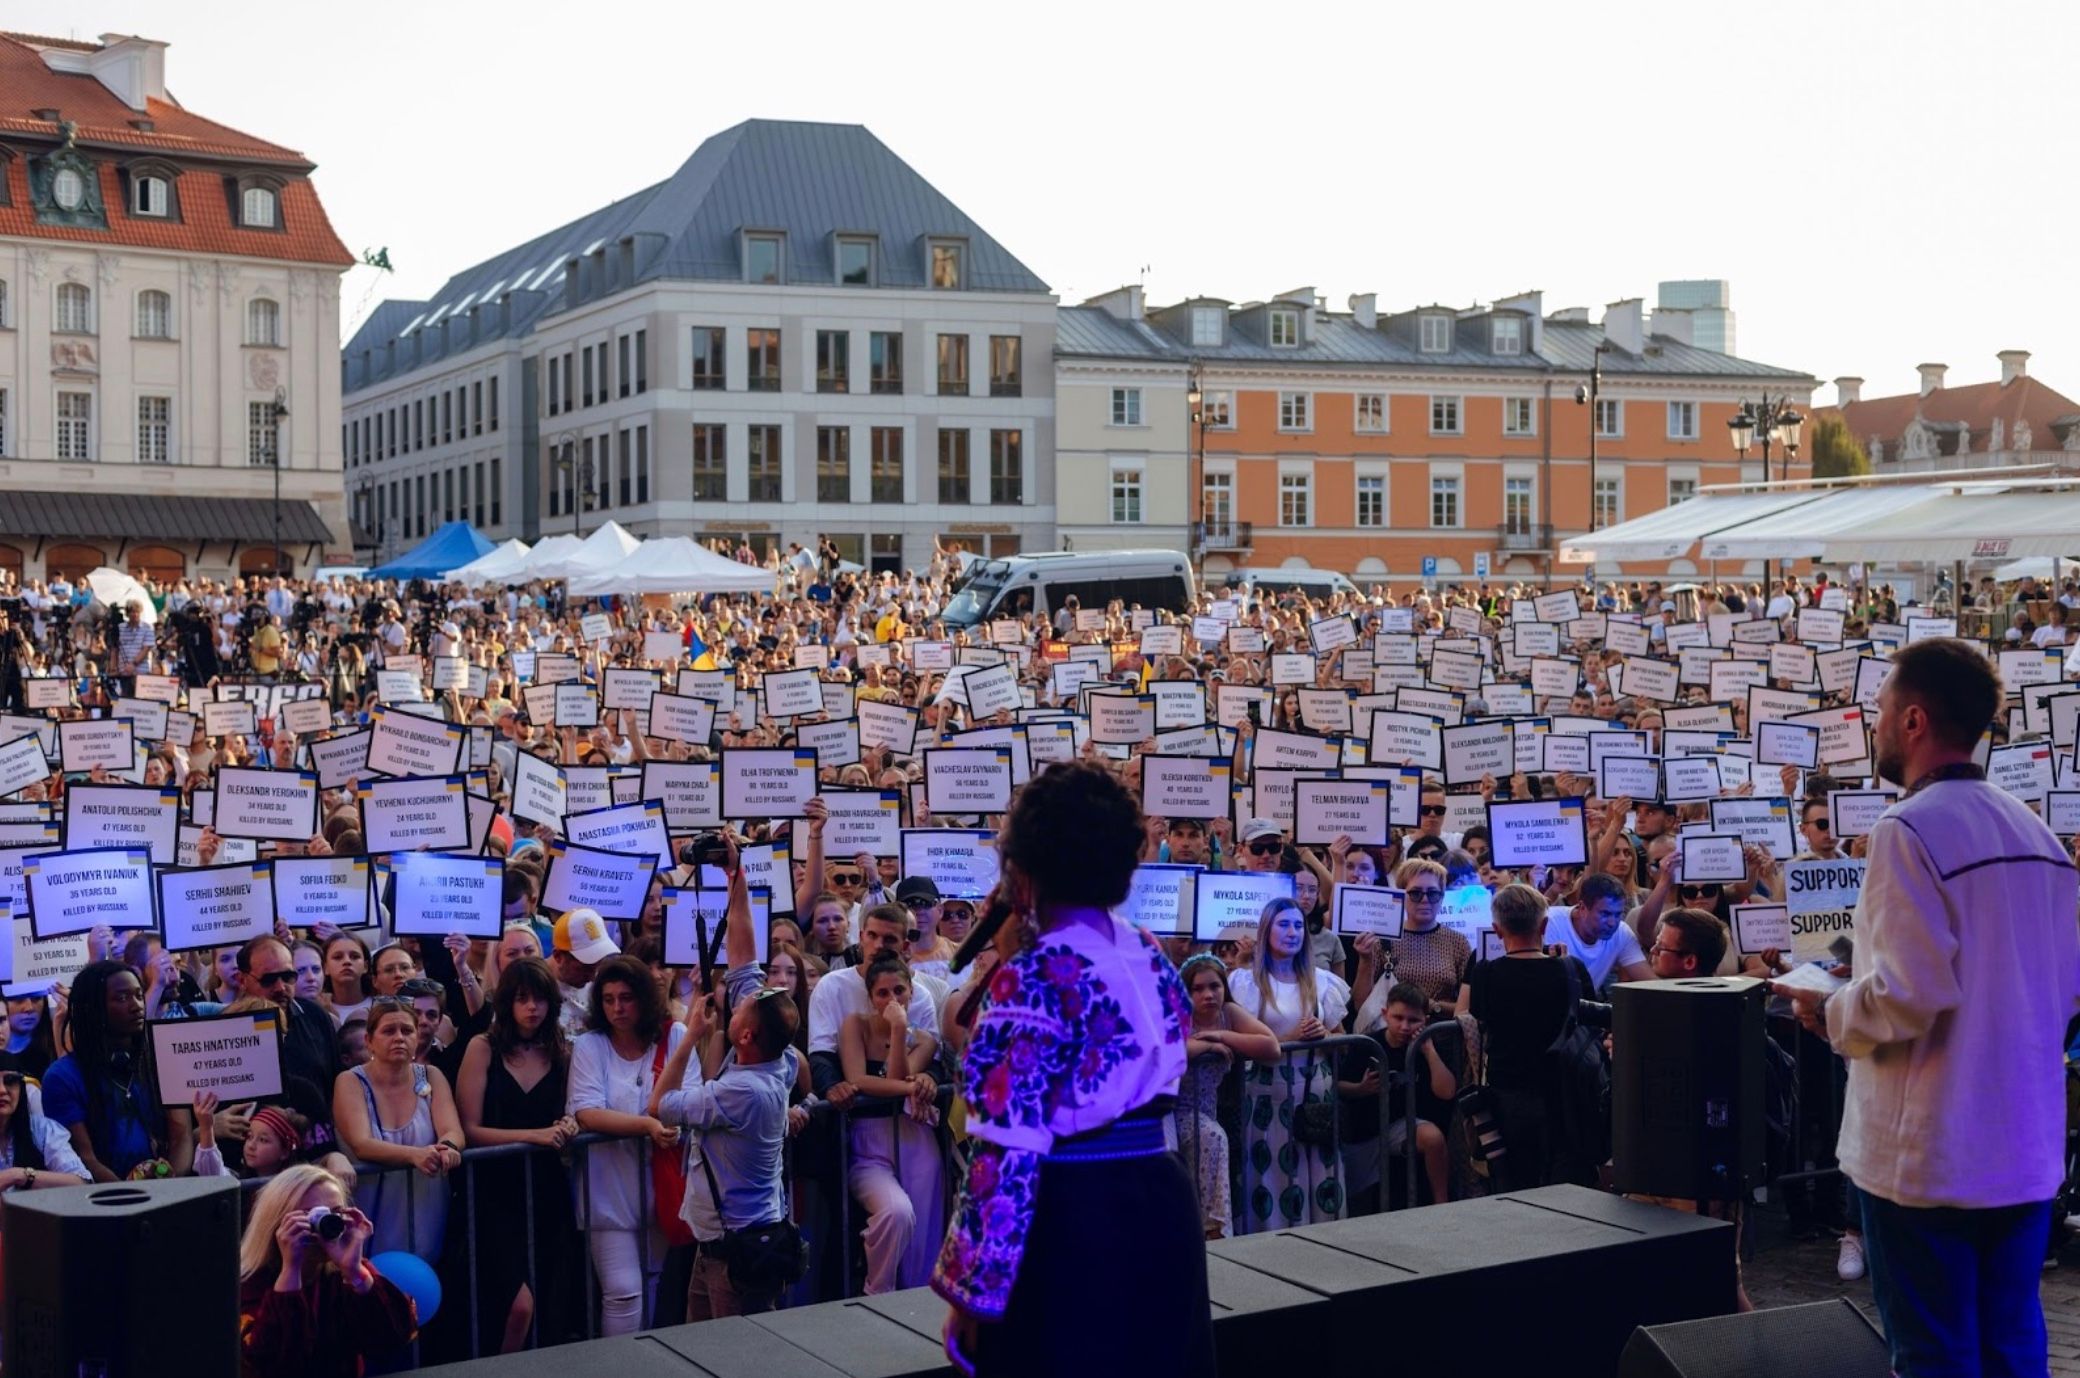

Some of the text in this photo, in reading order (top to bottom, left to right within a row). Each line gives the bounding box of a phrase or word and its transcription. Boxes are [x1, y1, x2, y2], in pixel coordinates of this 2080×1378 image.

[1425, 558, 1435, 570] P
[402, 745, 419, 755] YEARS
[418, 748, 430, 757] OLD
[386, 755, 434, 770] KILLED BY RUSSIANS
[226, 785, 308, 798] OLEKSANDR YEROKHIN
[1311, 795, 1339, 804] TELMAN
[81, 805, 162, 817] ANATOLII POLISHCHUK
[238, 816, 258, 824] KILLED
[266, 818, 293, 826] RUSSIANS
[405, 813, 425, 822] YEARS
[102, 824, 146, 832] 47 YEARS OLD
[1504, 819, 1530, 828] MYKOLA
[389, 827, 446, 837] KILLED BY RUSSIANS
[1526, 832, 1544, 840] YEARS
[92, 839, 114, 847] KILLED
[123, 840, 153, 848] RUSSIANS
[833, 836, 852, 844] KILLED
[1538, 844, 1564, 852] RUSSIANS
[46, 868, 139, 886] VOLODYMYR IVANIUK
[572, 865, 633, 880] SERHII KRAVETS
[299, 875, 323, 884] SOFIIA
[448, 878, 485, 888] PASTUKH
[79, 888, 102, 898] YEARS
[103, 887, 117, 896] OLD
[588, 884, 608, 892] YEARS
[607, 885, 620, 893] OLD
[185, 888, 212, 900] SERHII
[308, 892, 327, 900] YEARS
[1213, 890, 1243, 900] MYKOLA
[460, 896, 473, 904] OLD
[568, 895, 589, 903] KILLED
[596, 898, 624, 907] RUSSIANS
[62, 903, 128, 916] KILLED BY RUSSIANS
[199, 903, 242, 914] 44 YEARS OLD
[294, 904, 347, 913] KILLED BY RUSSIANS
[1235, 908, 1252, 916] YEARS
[420, 911, 443, 919] KILLED
[452, 912, 480, 920] RUSSIANS
[191, 918, 251, 932] KILLED BY RUSSIANS
[42, 950, 64, 959] YEARS
[64, 949, 77, 957] OLD
[26, 968, 50, 977] KILLED
[49, 967, 58, 975] BY
[172, 1036, 260, 1054] TARAS HNATYSHYN
[193, 1056, 242, 1070] 47 YEARS OLD
[186, 1073, 255, 1088] KILLED BY RUSSIANS
